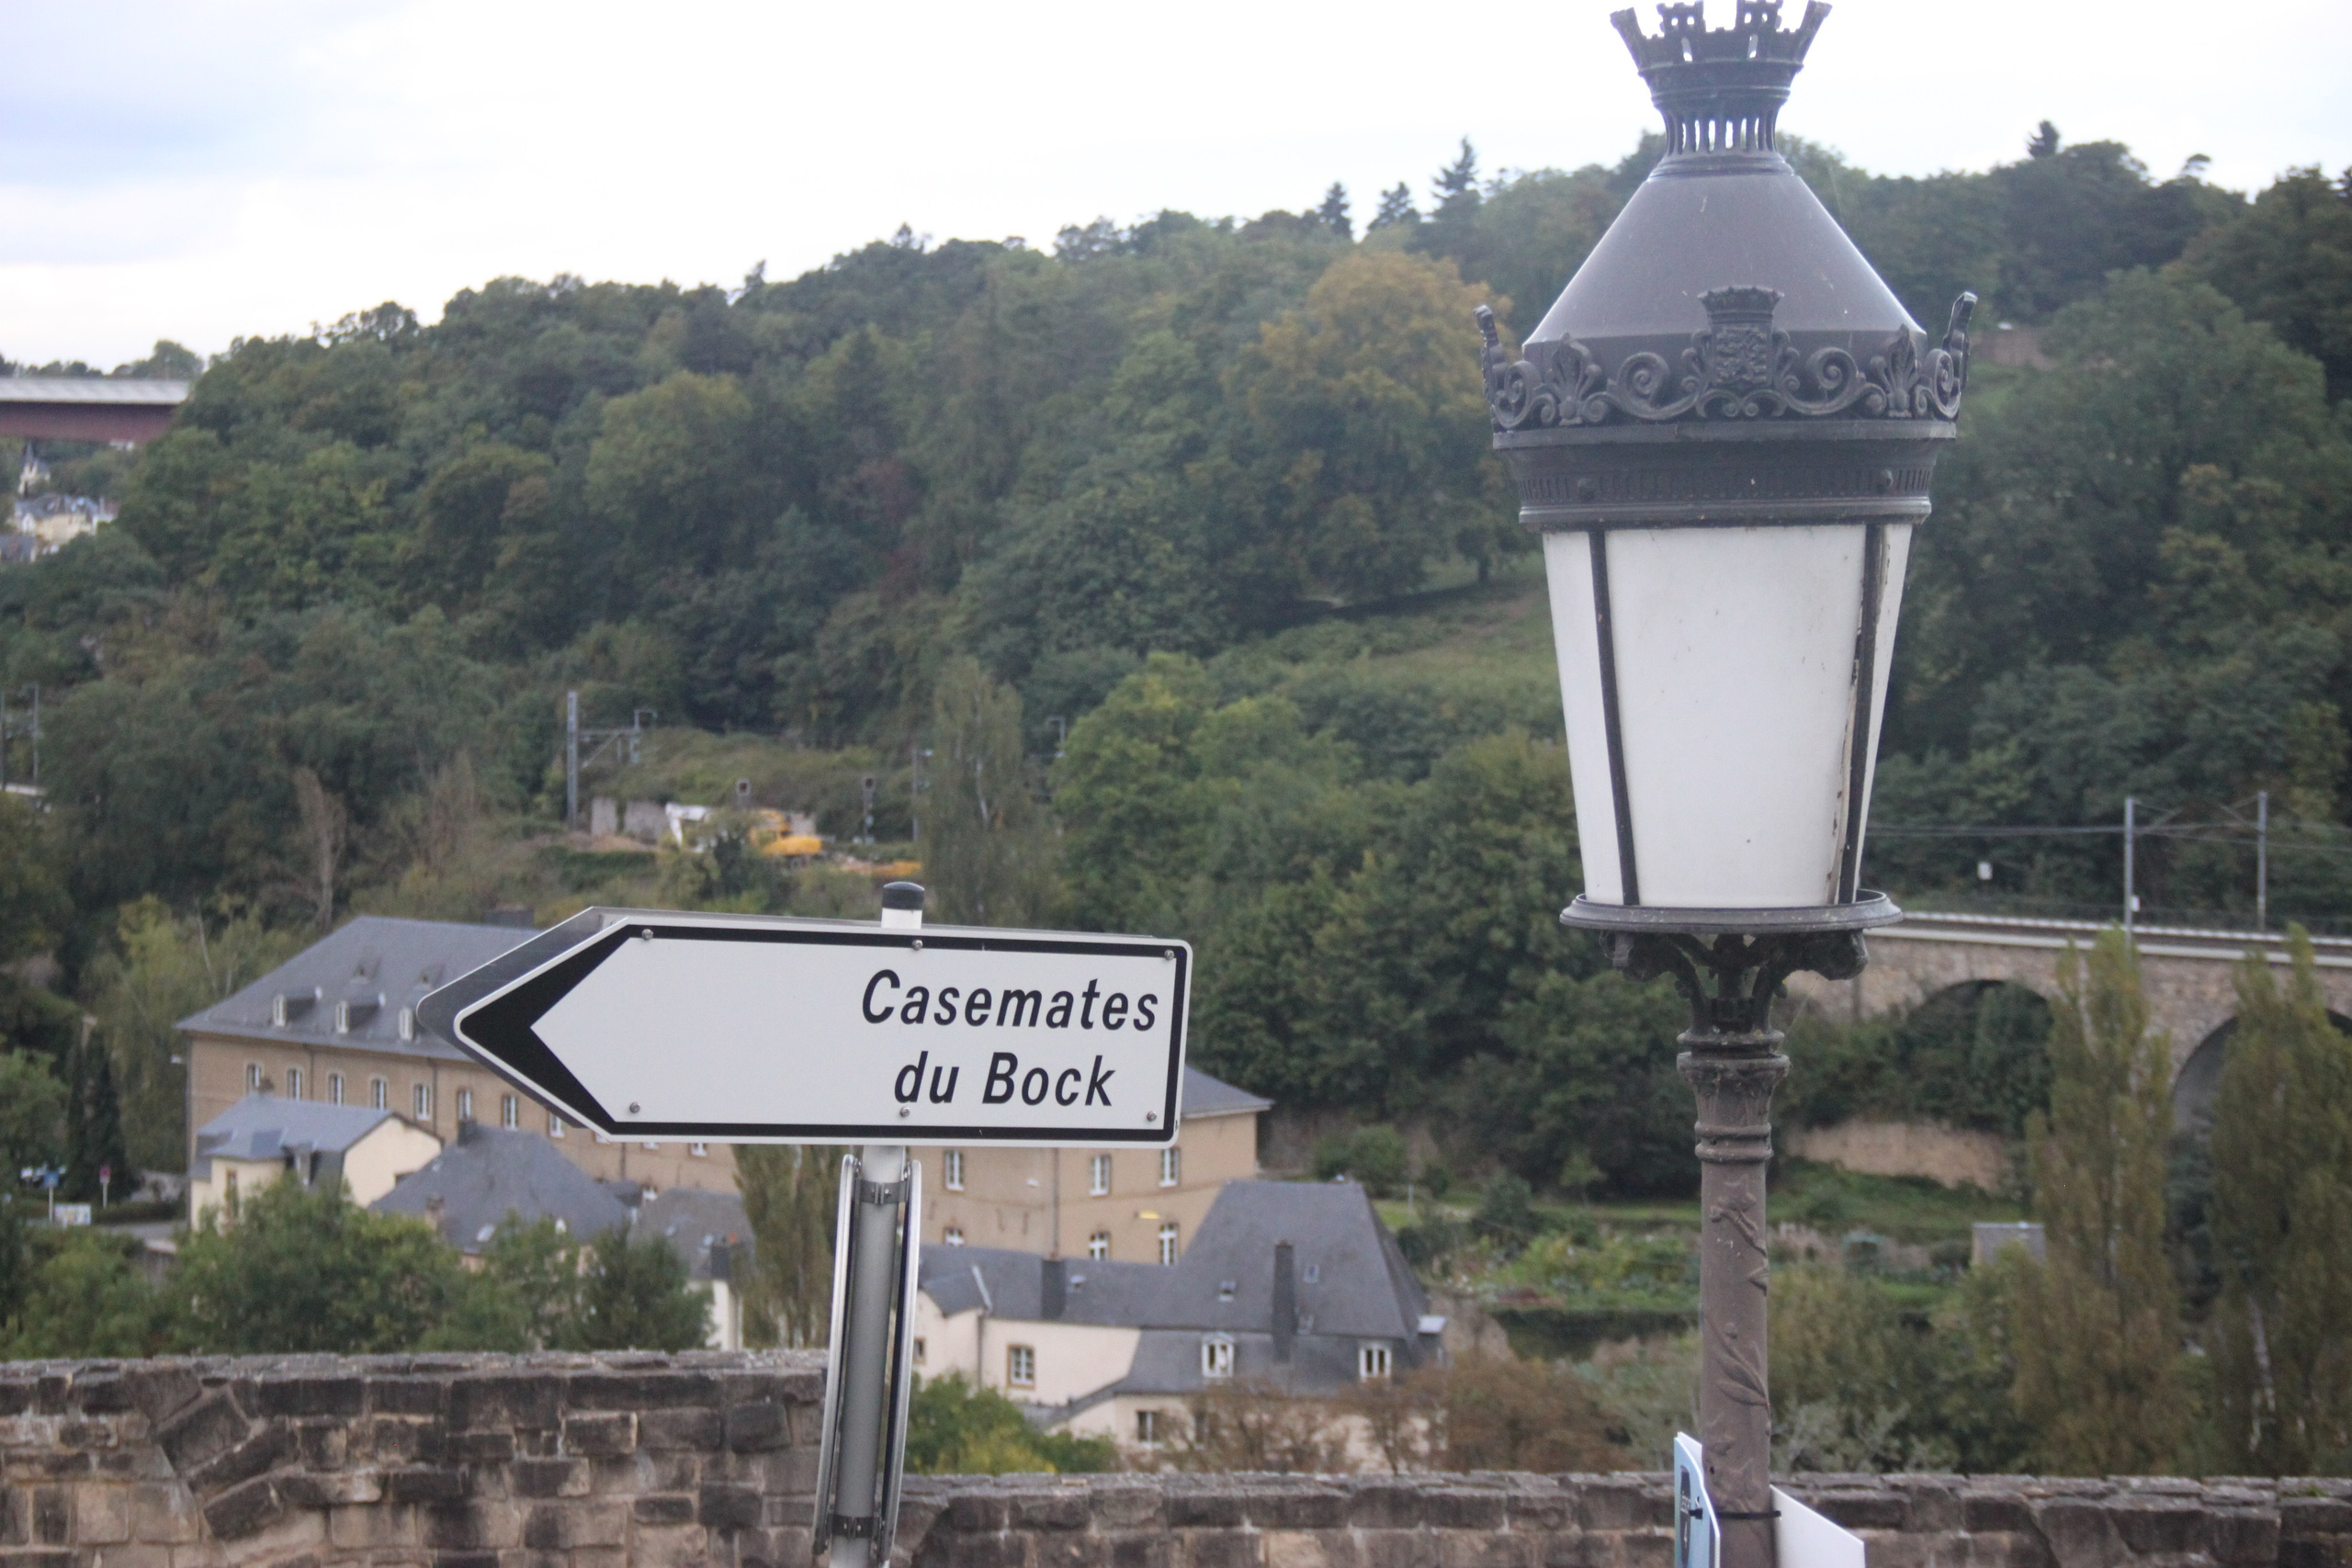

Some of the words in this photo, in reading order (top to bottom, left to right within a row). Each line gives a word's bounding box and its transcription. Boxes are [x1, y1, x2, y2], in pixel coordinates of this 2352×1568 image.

[862, 968, 1159, 1032] Casemates
[894, 1050, 960, 1105] du
[982, 1051, 1115, 1107] Bock
